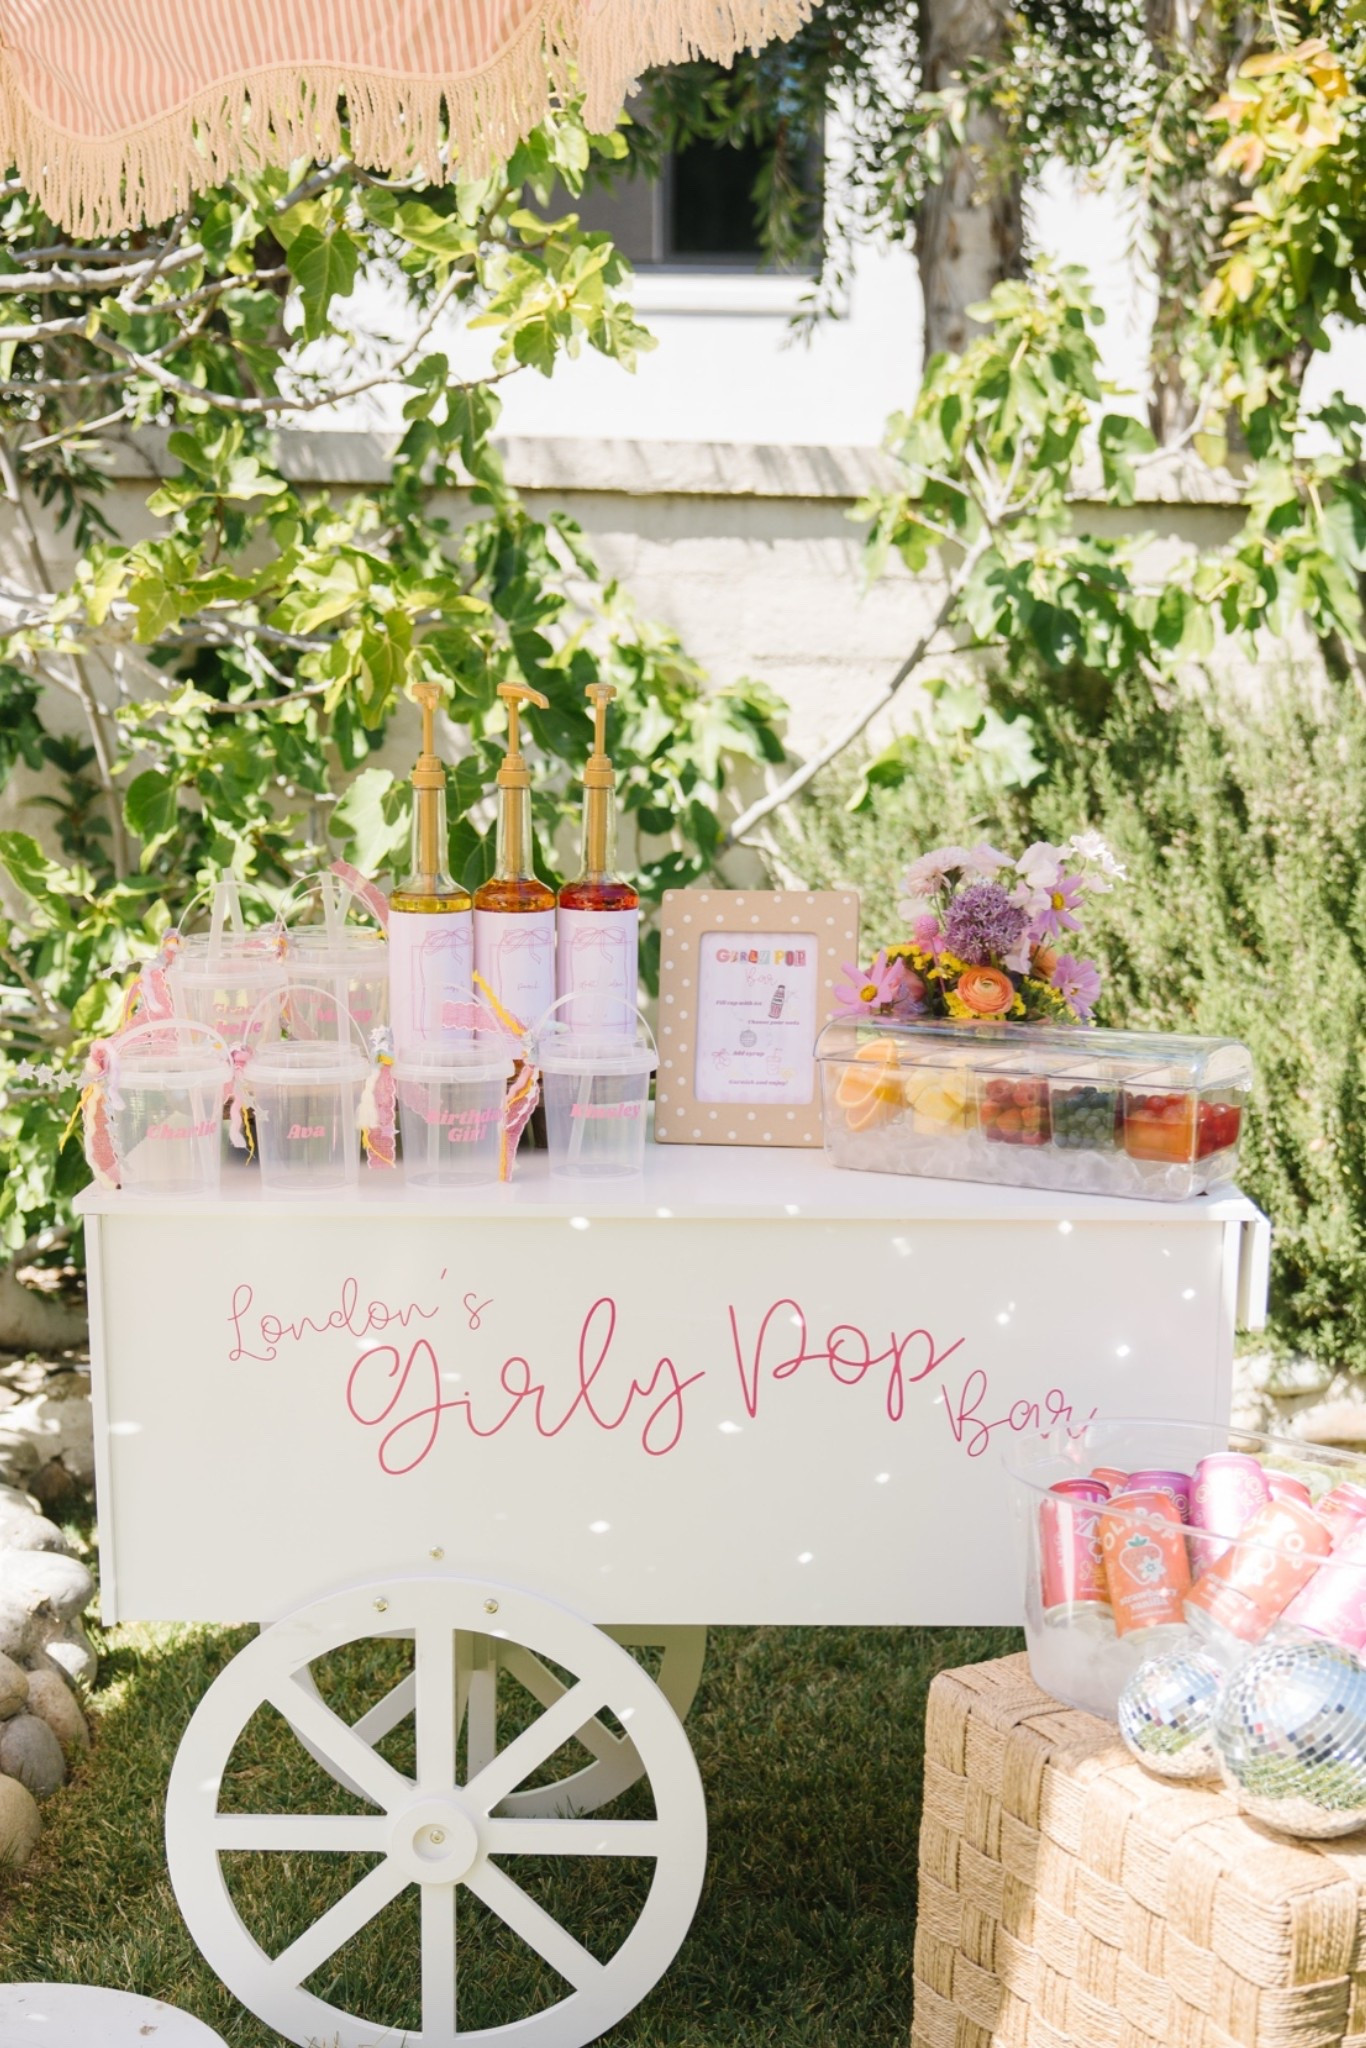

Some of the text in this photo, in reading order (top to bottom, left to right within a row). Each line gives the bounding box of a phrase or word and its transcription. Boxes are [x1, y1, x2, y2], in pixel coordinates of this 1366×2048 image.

[773, 948, 807, 966] POP
[286, 1123, 326, 1141] Ava
[226, 1267, 494, 1362] London's
[346, 1296, 966, 1477] Girly Pop
[941, 1369, 1098, 1458] Bar
